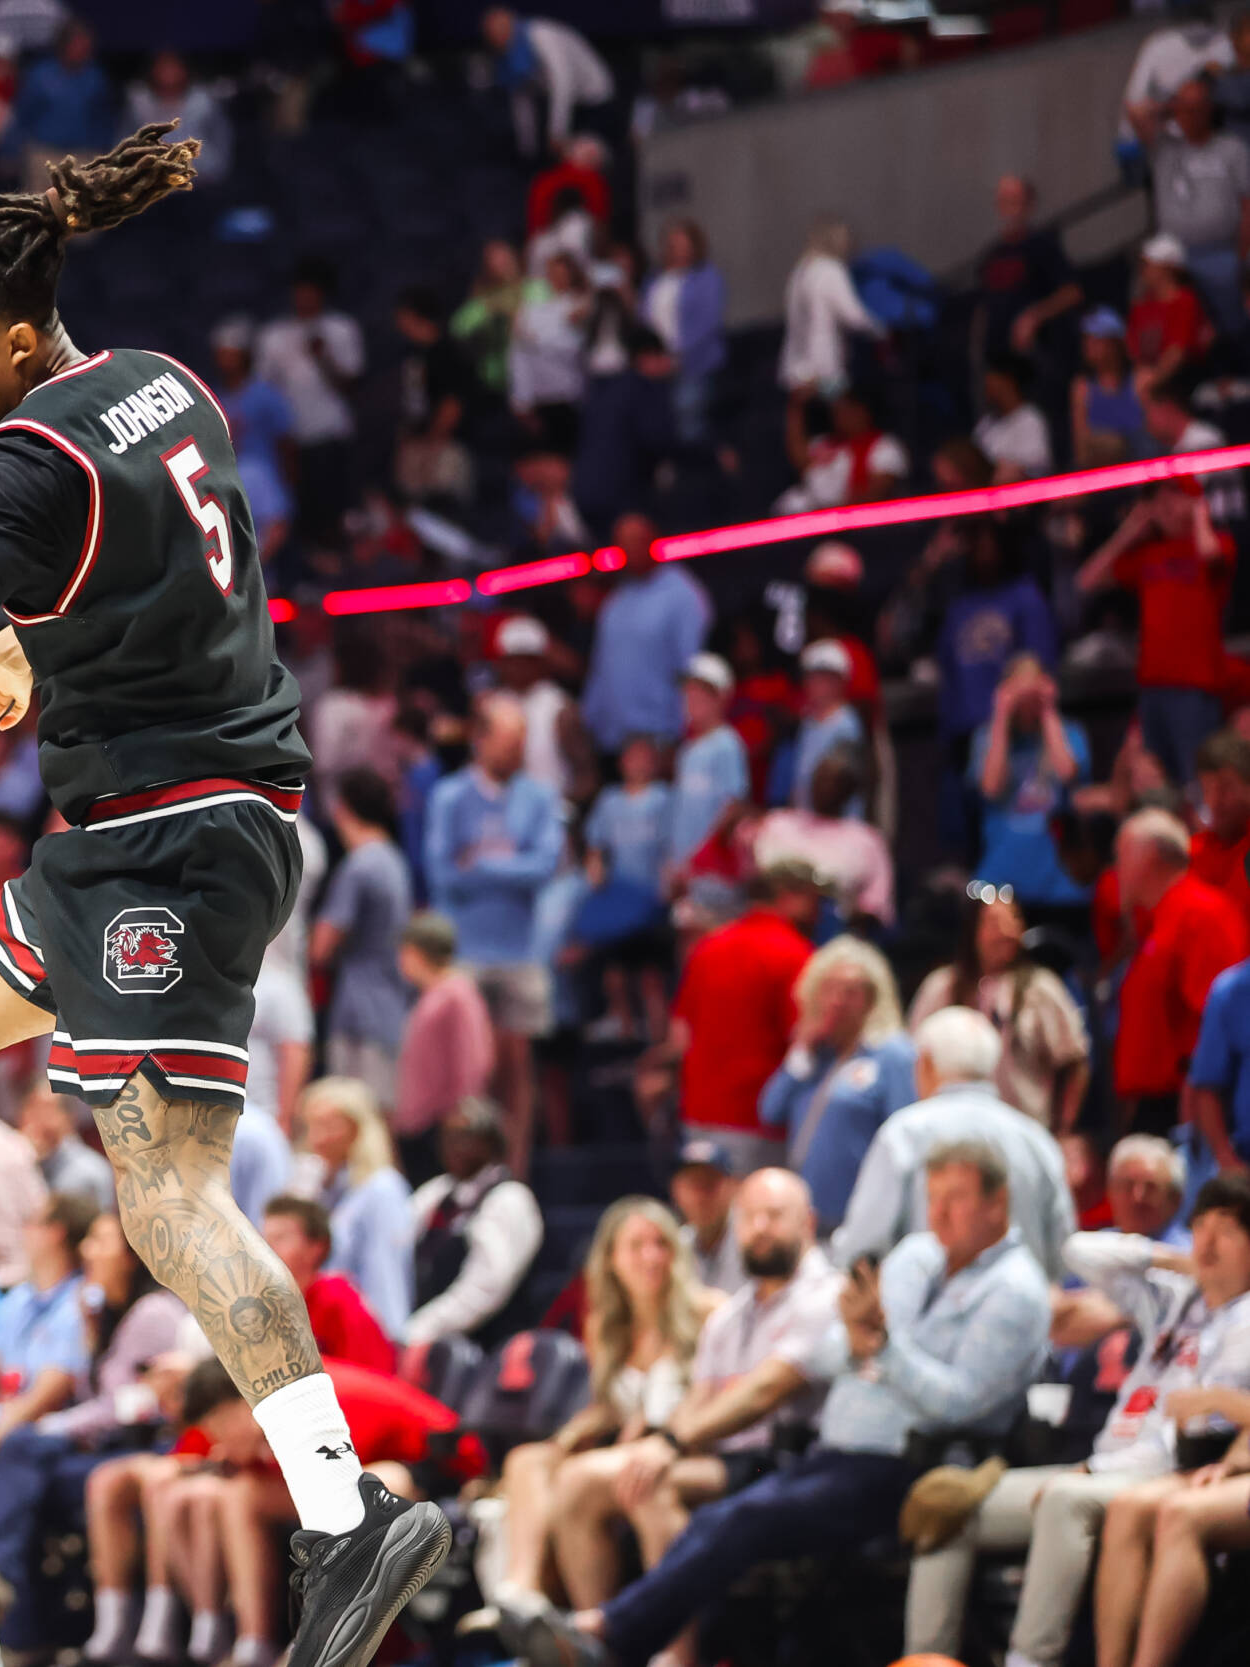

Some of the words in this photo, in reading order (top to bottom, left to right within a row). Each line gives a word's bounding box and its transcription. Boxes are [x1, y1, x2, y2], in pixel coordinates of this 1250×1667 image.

[100, 372, 195, 454] JOHNSON
[159, 435, 234, 597] 5
[252, 1361, 302, 1394] CHILD
